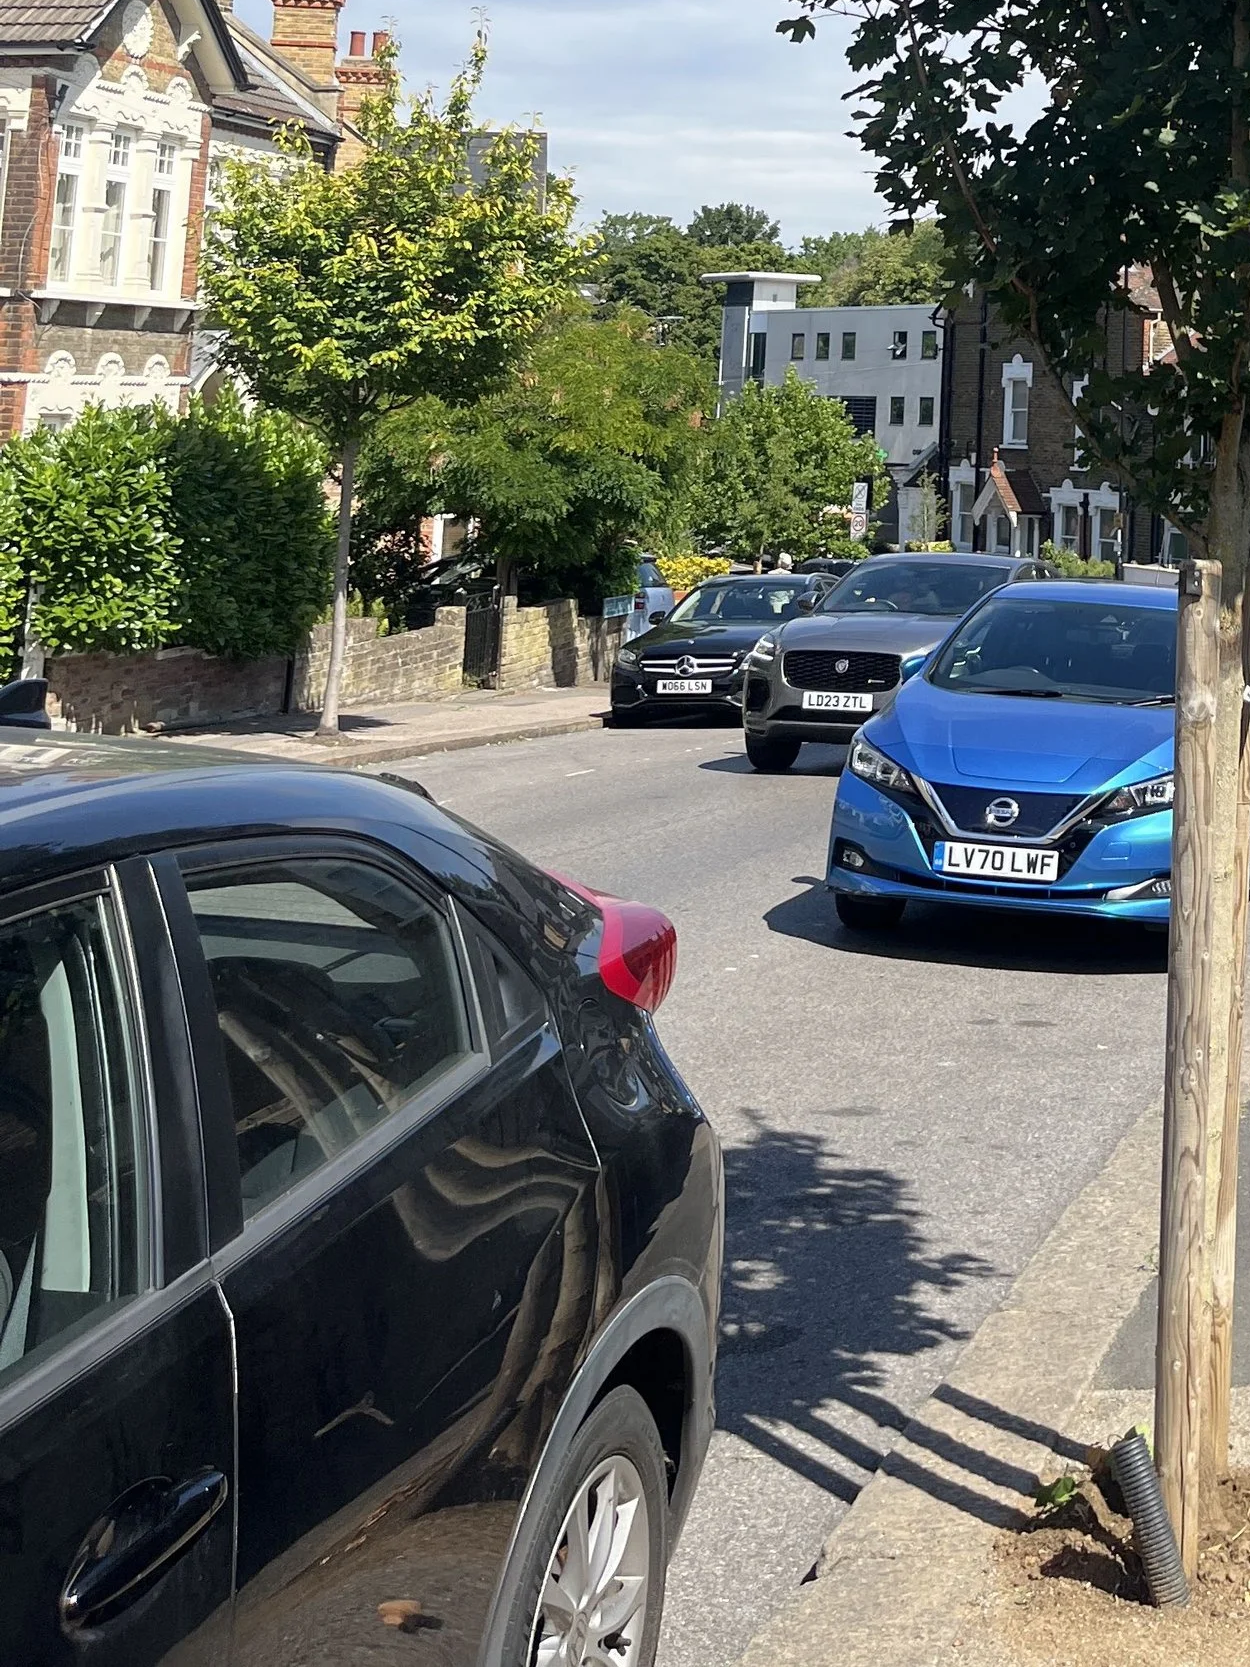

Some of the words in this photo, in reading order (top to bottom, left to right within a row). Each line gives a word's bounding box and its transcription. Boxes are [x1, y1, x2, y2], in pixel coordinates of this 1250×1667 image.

[688, 681, 707, 691] LSN
[808, 694, 840, 707] LD23
[843, 696, 867, 708] ZTL
[948, 846, 1005, 871] LV70
[1011, 851, 1055, 875] LWF
